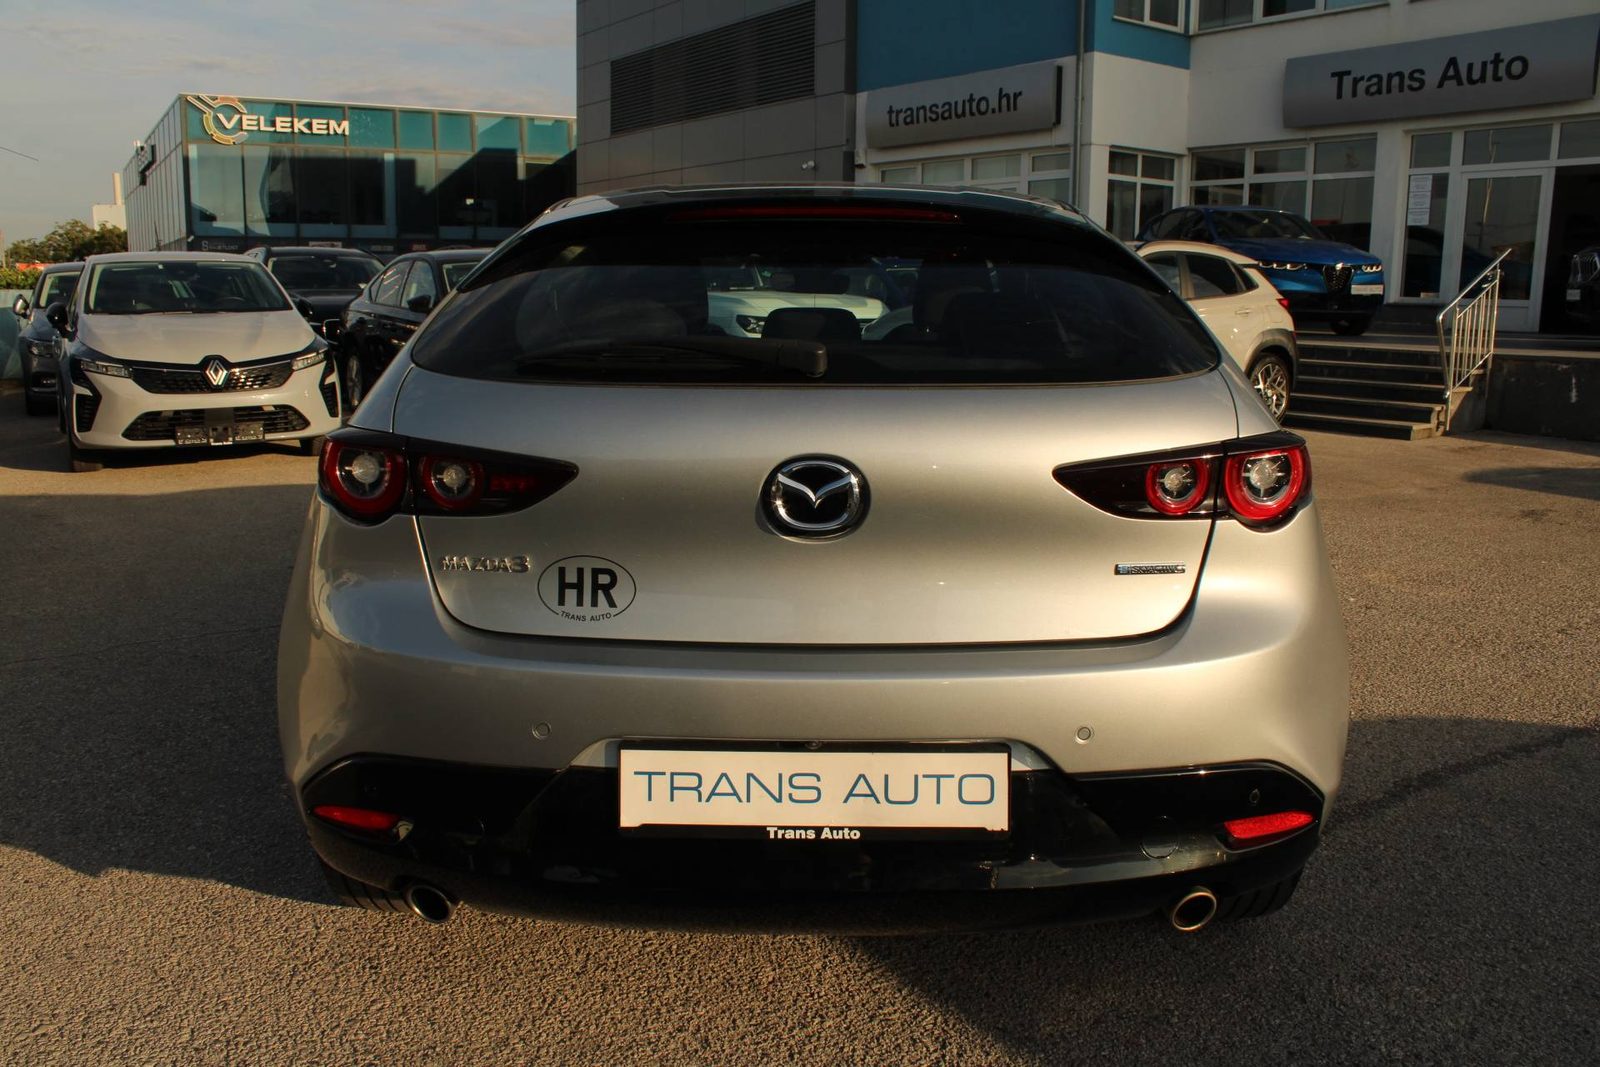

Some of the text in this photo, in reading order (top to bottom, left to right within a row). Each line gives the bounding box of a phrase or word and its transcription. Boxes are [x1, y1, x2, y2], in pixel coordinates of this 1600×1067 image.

[1330, 51, 1528, 100] Trans Auto
[887, 87, 1023, 128] transauto.hr
[217, 113, 349, 136] VELEKEM
[441, 555, 531, 573] MAZDA3
[557, 566, 618, 608] HR
[560, 610, 612, 622] TRANS AUTO
[634, 771, 995, 805] TRANS AUTO
[766, 826, 861, 840] Trans Auto
